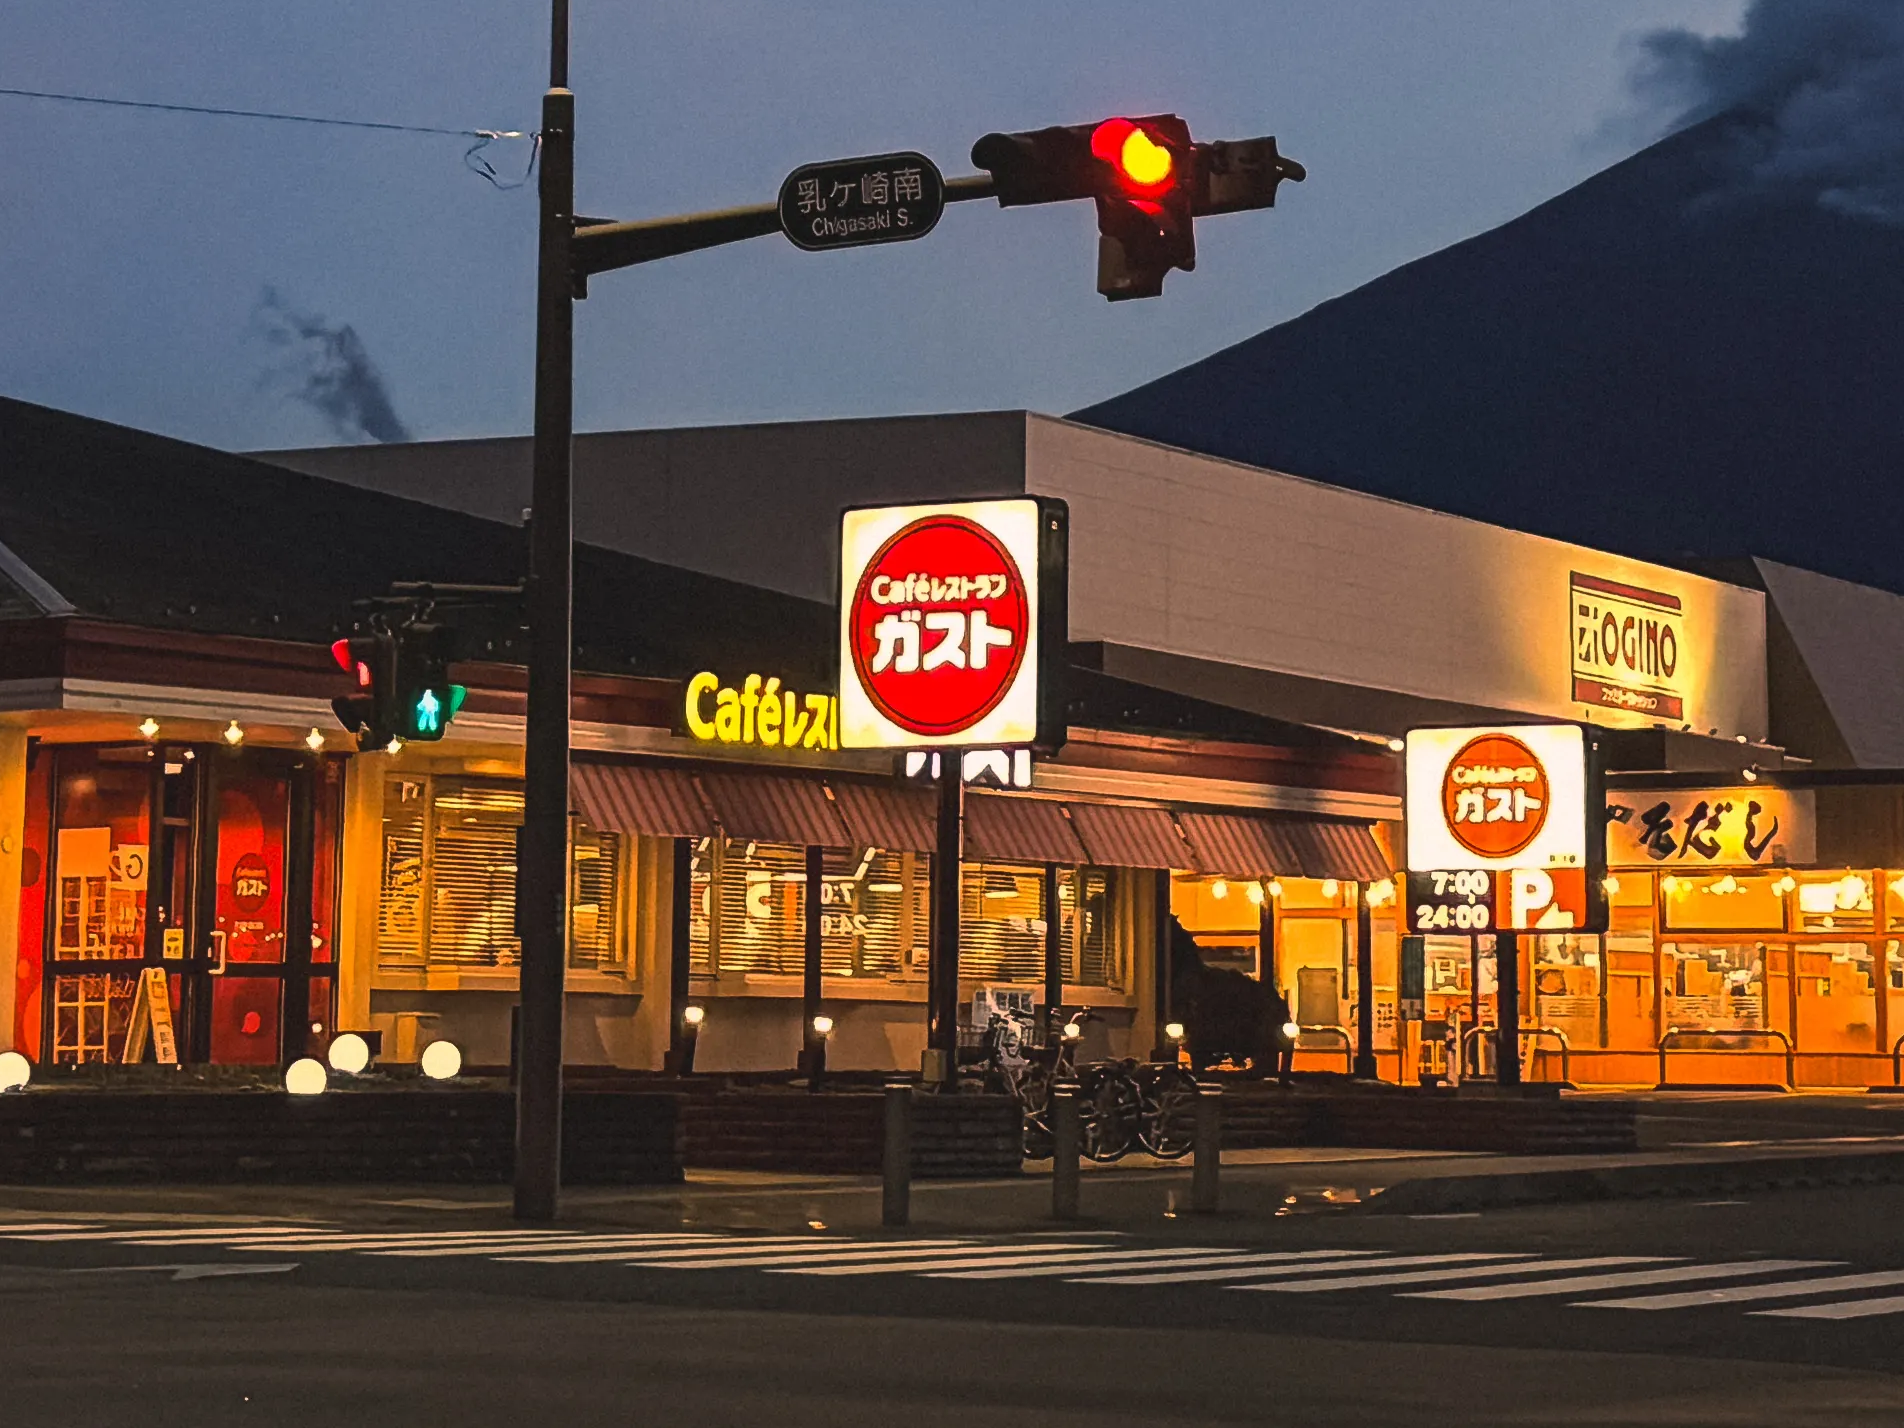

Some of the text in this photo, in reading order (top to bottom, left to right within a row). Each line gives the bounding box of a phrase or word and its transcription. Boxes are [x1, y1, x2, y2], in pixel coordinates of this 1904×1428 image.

[812, 208, 914, 236] Chigasaki S.
[872, 610, 1013, 673] ガスト
[1601, 611, 1677, 678] OGINO
[1455, 787, 1542, 823] ガスト
[1431, 870, 1490, 895] 7:00
[1511, 869, 1554, 929] P
[1416, 904, 1490, 929] 24:00
